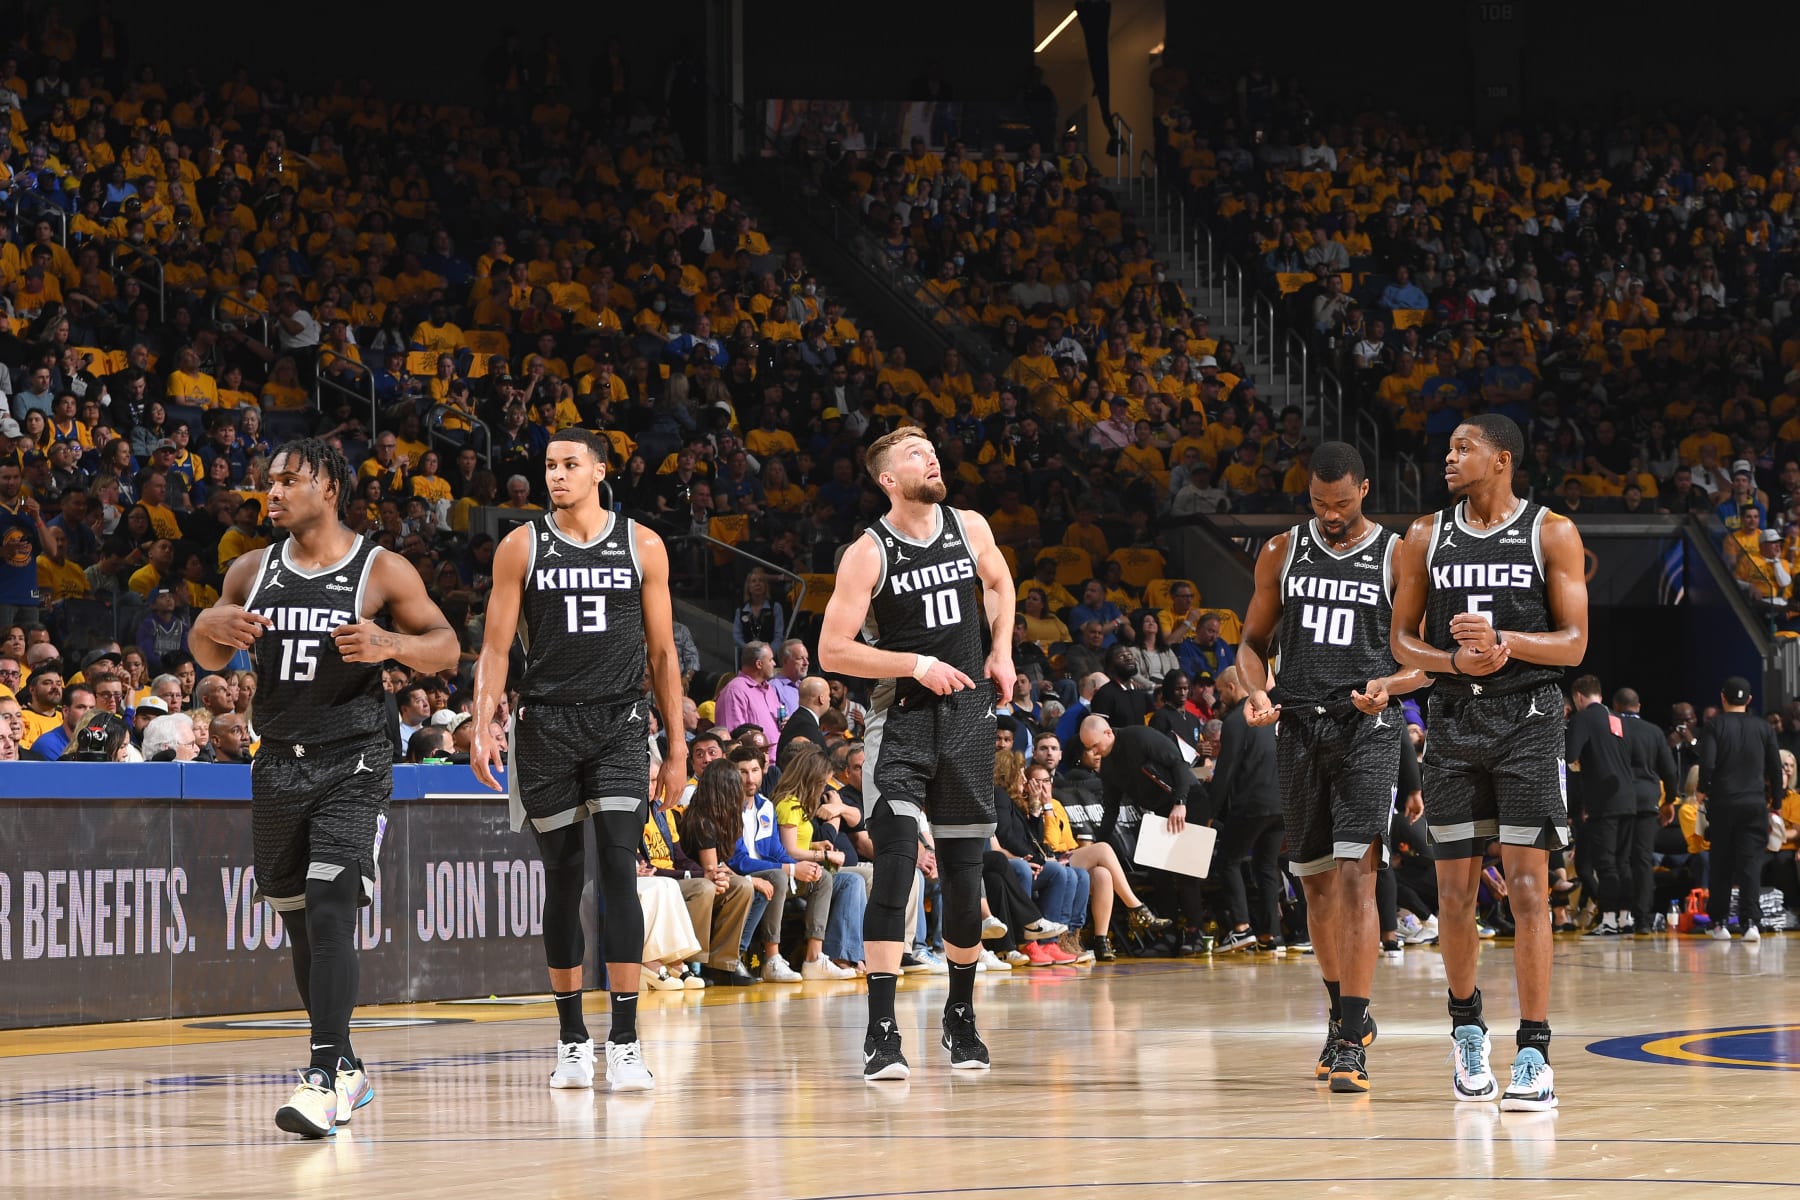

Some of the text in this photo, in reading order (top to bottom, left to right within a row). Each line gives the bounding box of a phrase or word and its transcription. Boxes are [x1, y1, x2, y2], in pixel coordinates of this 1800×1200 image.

[1443, 521, 1454, 531] 6
[540, 532, 550, 542] 6
[885, 537, 895, 548] 6
[942, 539, 962, 549] dialpad
[1300, 536, 1310, 546] 6
[1499, 536, 1527, 545] dialpad
[600, 549, 627, 557] dialpad
[269, 558, 280, 570] 6
[1353, 561, 1379, 570] dialpad
[536, 567, 632, 591] KINGS
[890, 557, 975, 596] KINGS
[1432, 563, 1534, 590] KINGS
[325, 582, 354, 592] dialpad
[1287, 575, 1381, 606] KINGS
[563, 595, 608, 634] 13
[921, 588, 962, 629] 10
[1301, 603, 1355, 646] 40
[279, 638, 321, 682] 15
[417, 861, 486, 942] JOIN
[23, 867, 196, 960] BENEFITS.
